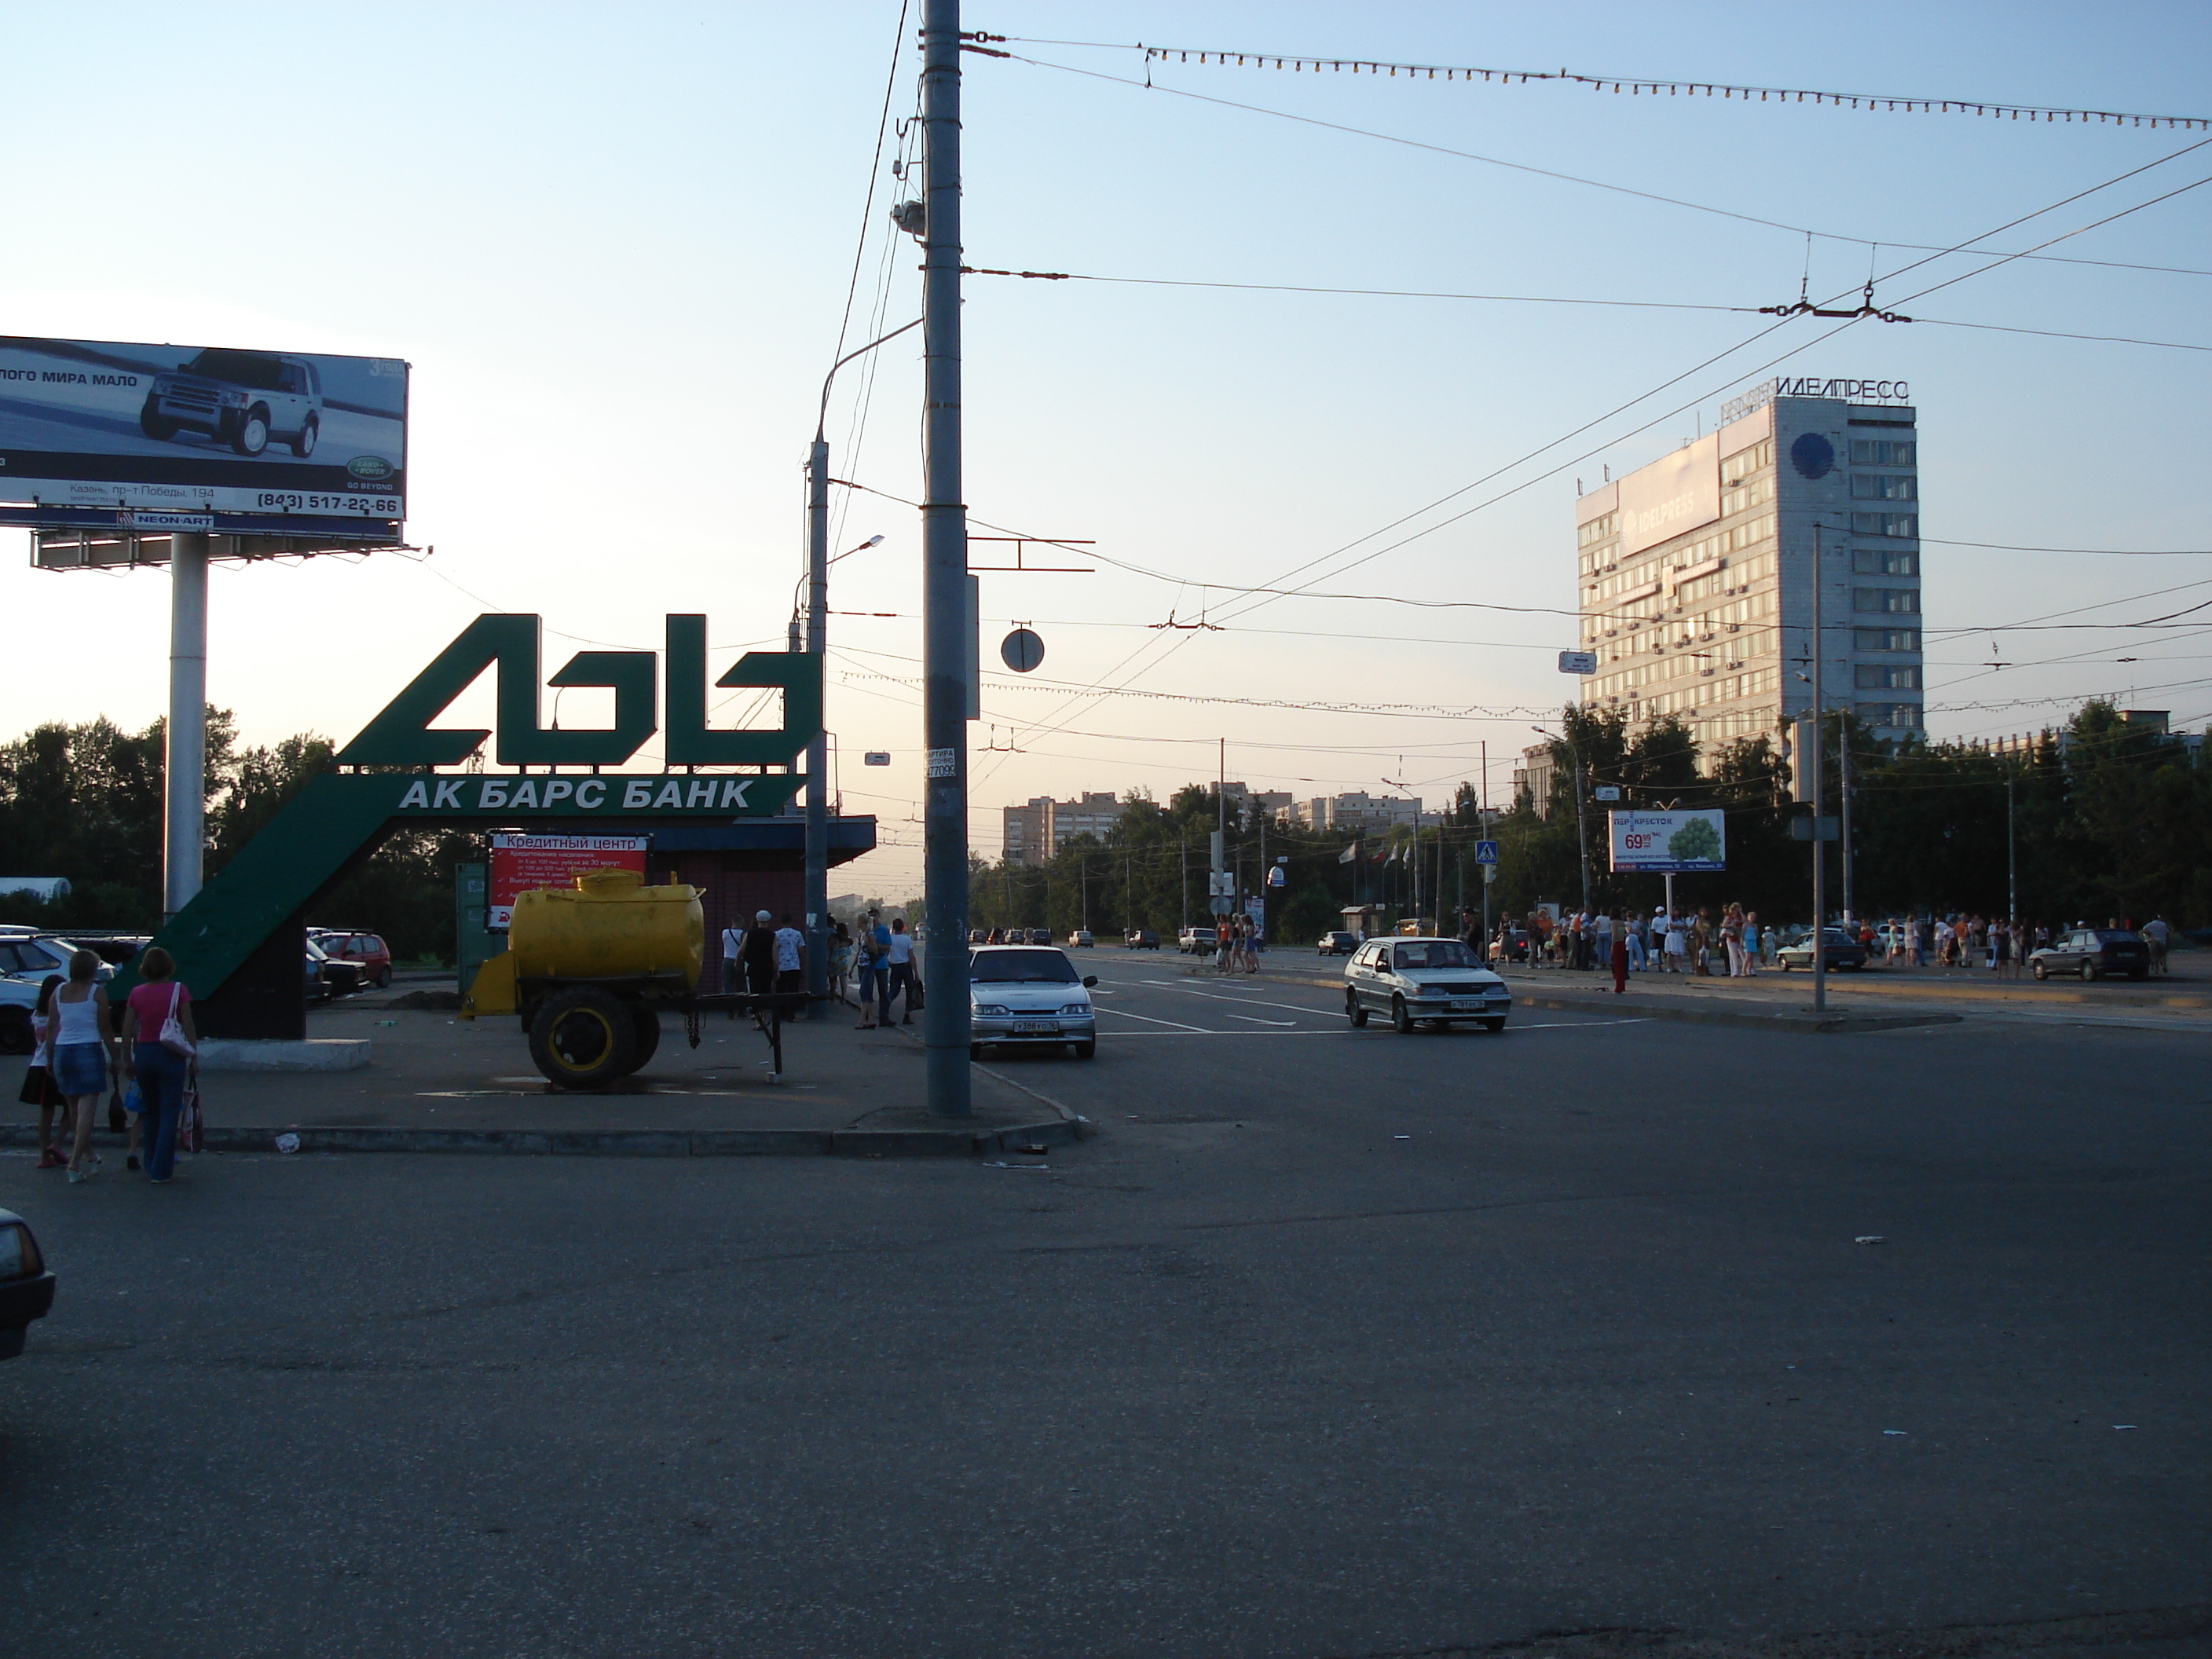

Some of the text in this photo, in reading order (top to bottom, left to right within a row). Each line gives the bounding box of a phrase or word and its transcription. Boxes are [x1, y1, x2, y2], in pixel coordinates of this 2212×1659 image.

[42, 372, 87, 384] МИРА
[93, 375, 137, 386] МАЛО
[1776, 376, 1909, 399] ИДЕЛПРЕСС
[112, 486, 138, 495] пр-т
[192, 488, 214, 498] 194
[361, 482, 393, 491] BEYOND
[258, 493, 397, 512] (843) 517-22-66
[1639, 491, 1694, 534] IDELPRESS
[399, 780, 753, 809] АК БАРС БАНК
[507, 836, 635, 851] Кредитный центр
[1625, 833, 1643, 849] 69
